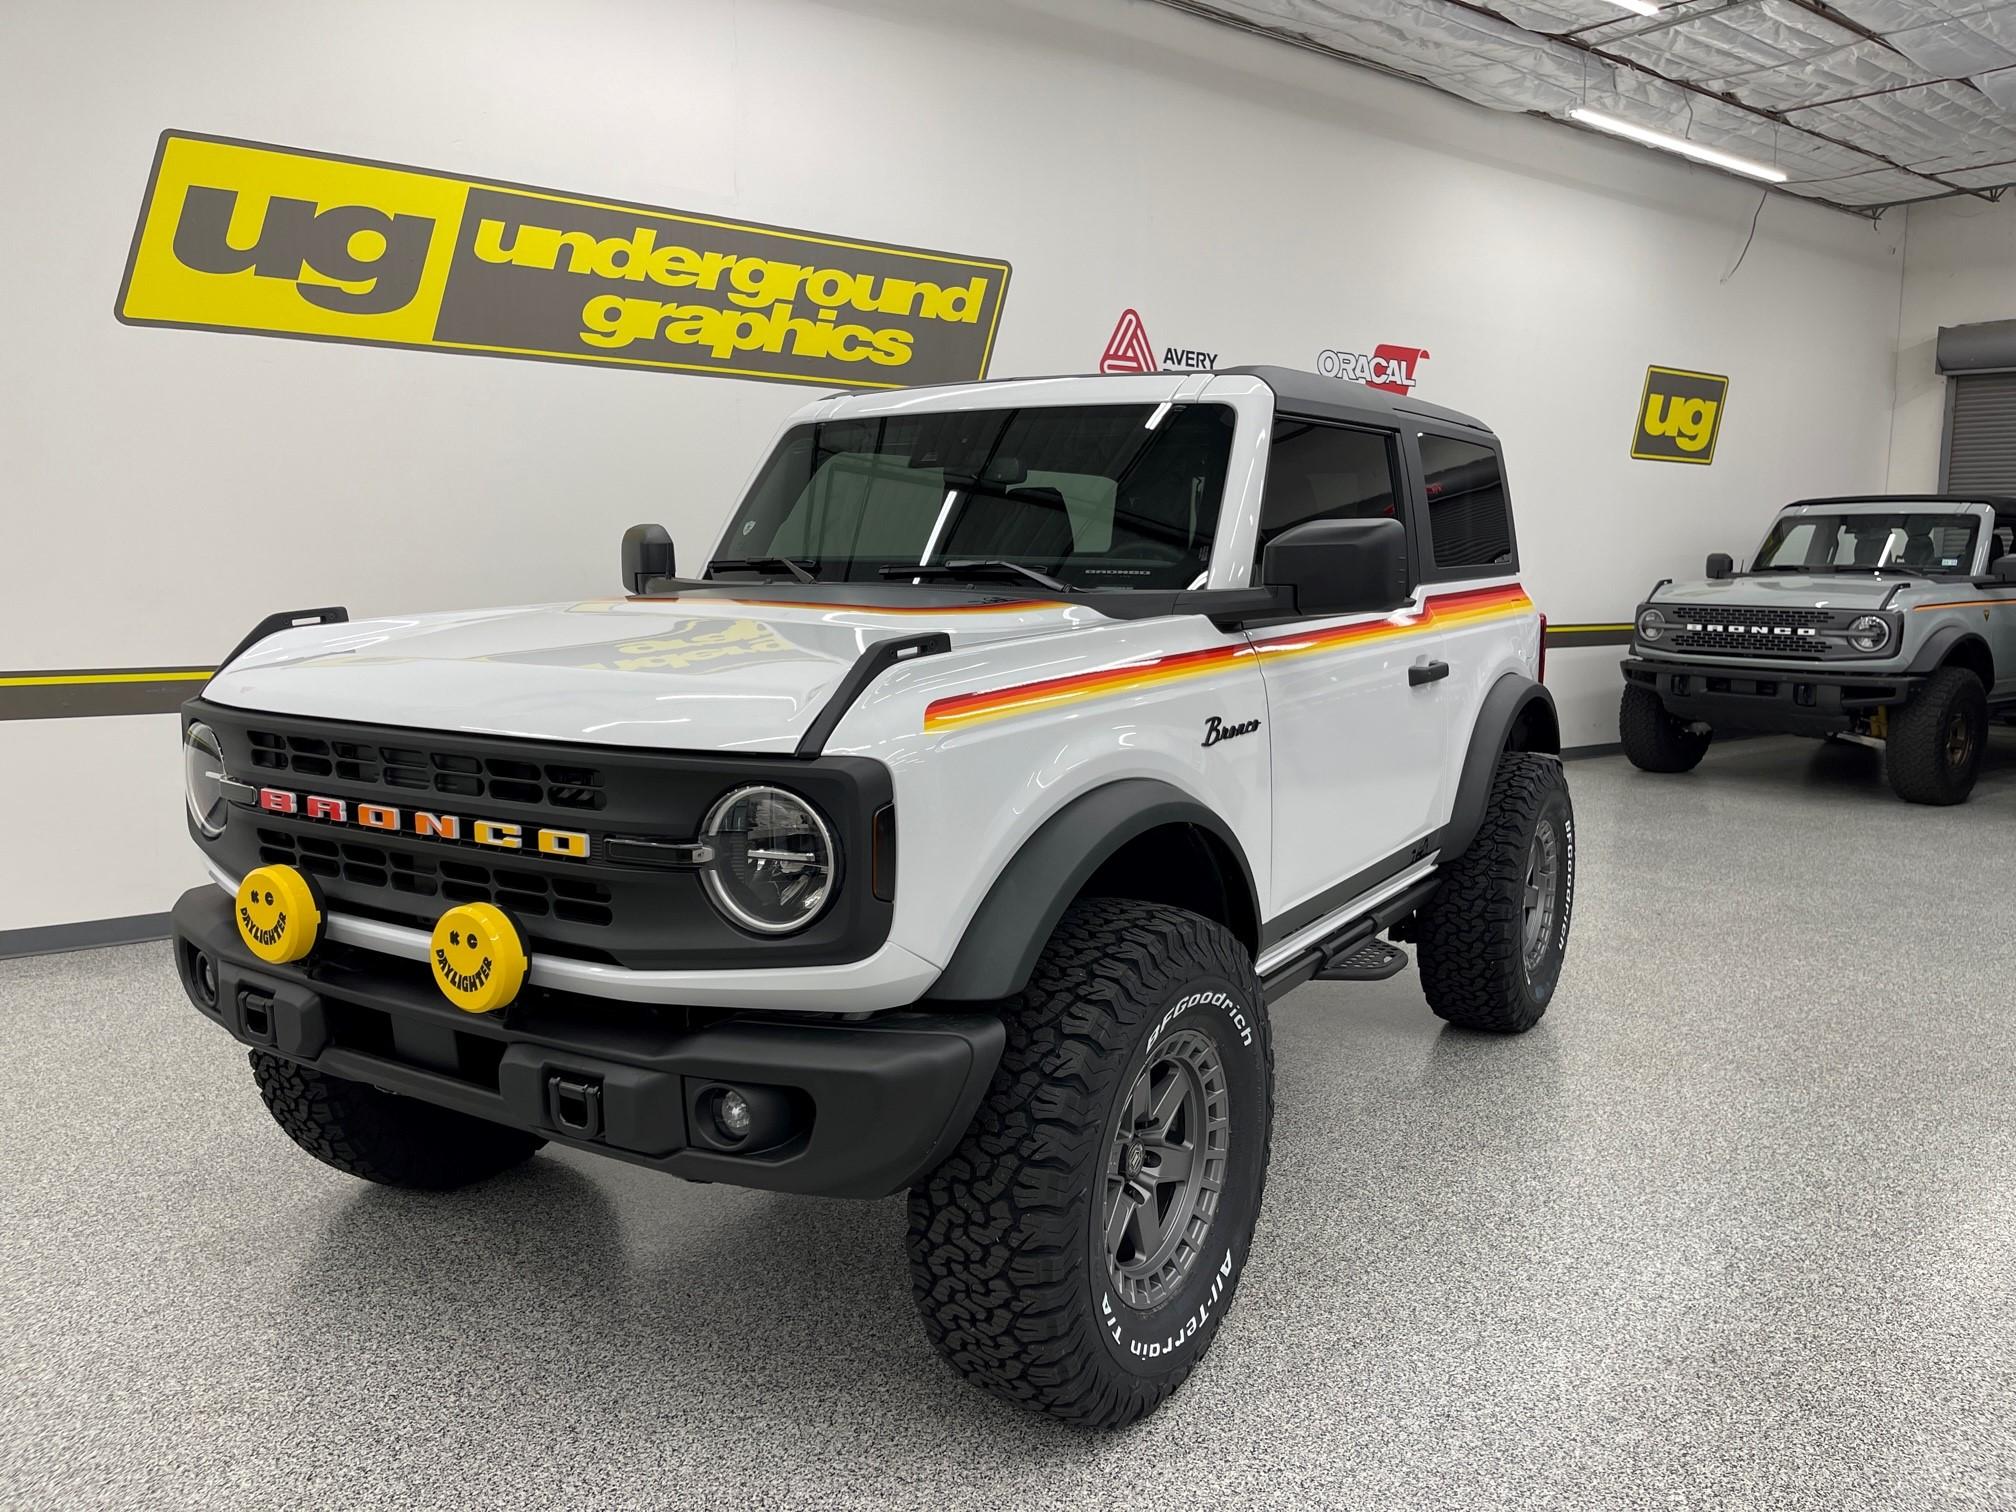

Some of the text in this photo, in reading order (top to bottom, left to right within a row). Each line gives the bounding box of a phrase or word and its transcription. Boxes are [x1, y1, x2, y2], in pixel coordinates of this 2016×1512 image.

[172, 184, 437, 315] ug
[473, 218, 988, 324] underground
[579, 293, 915, 366] graphics
[1162, 347, 1218, 370] AVERY
[1317, 349, 1416, 387] ORACAL
[1644, 393, 1718, 452] ug
[1686, 623, 1816, 636] BRONCO
[1201, 716, 1262, 747] Bronco
[260, 787, 591, 858] BRONCO
[240, 906, 287, 946] DAYLIGHTER
[435, 948, 493, 993] DAYLIGHTER
[1145, 990, 1253, 1056] BFGoodrich
[1130, 1247, 1232, 1361] All-Terrain
